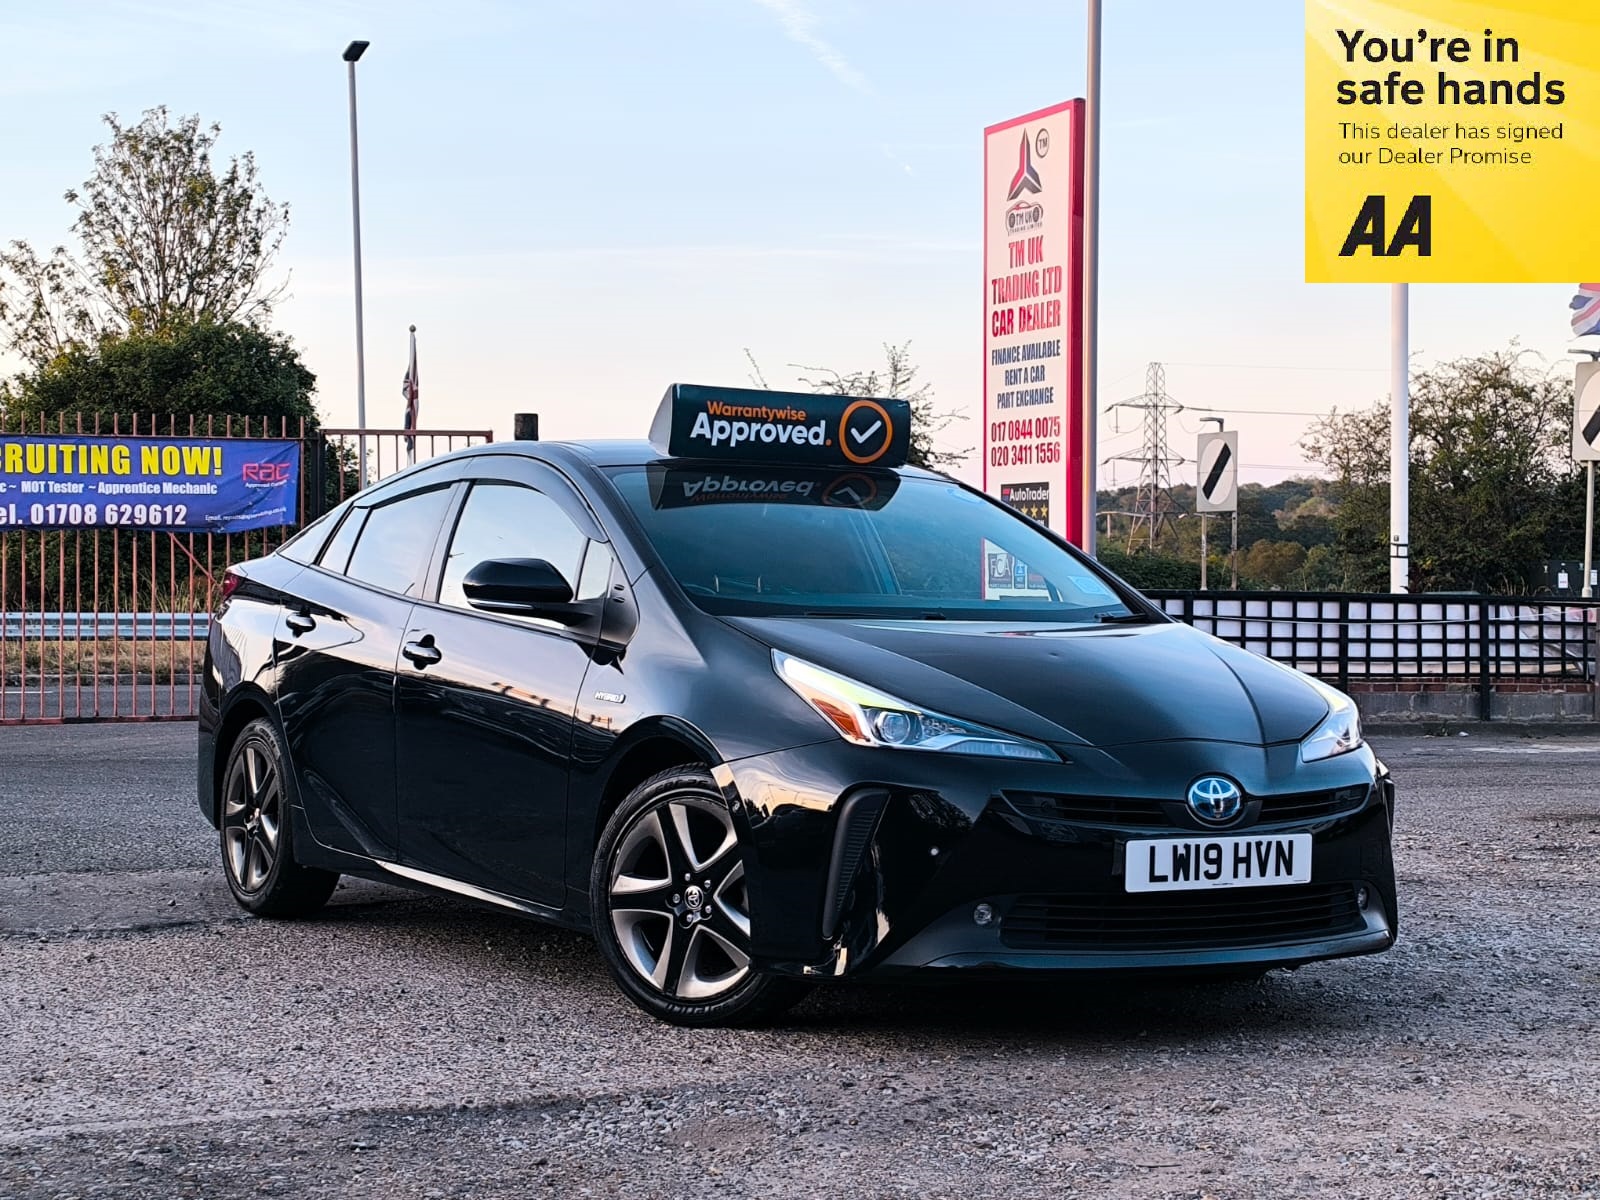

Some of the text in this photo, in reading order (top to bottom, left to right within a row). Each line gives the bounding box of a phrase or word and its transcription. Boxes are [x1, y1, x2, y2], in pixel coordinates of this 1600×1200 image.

[1039, 137, 1048, 149] TM
[1008, 235, 1044, 269] TM UK
[991, 265, 1062, 305] TRADING LTD
[992, 299, 1061, 338] CAR DEALER
[991, 339, 1061, 366] FINANCE AVAILABLE
[1005, 364, 1045, 387] RENT A CAR
[706, 400, 807, 422] Warrantywise
[997, 386, 1054, 410] PART EXCHANGE
[991, 416, 1061, 443] 017 0844 0075
[0, 443, 223, 475] RUITING NOW!
[991, 441, 1061, 467] 020 3411 1556
[21, 480, 46, 493] MOT
[48, 481, 84, 493] Tester
[98, 482, 161, 495] Apprentice
[162, 482, 218, 495] Mechanic
[30, 503, 97, 525] 01708
[105, 504, 187, 525] 629612
[1149, 840, 1294, 883] LW19 HVN
